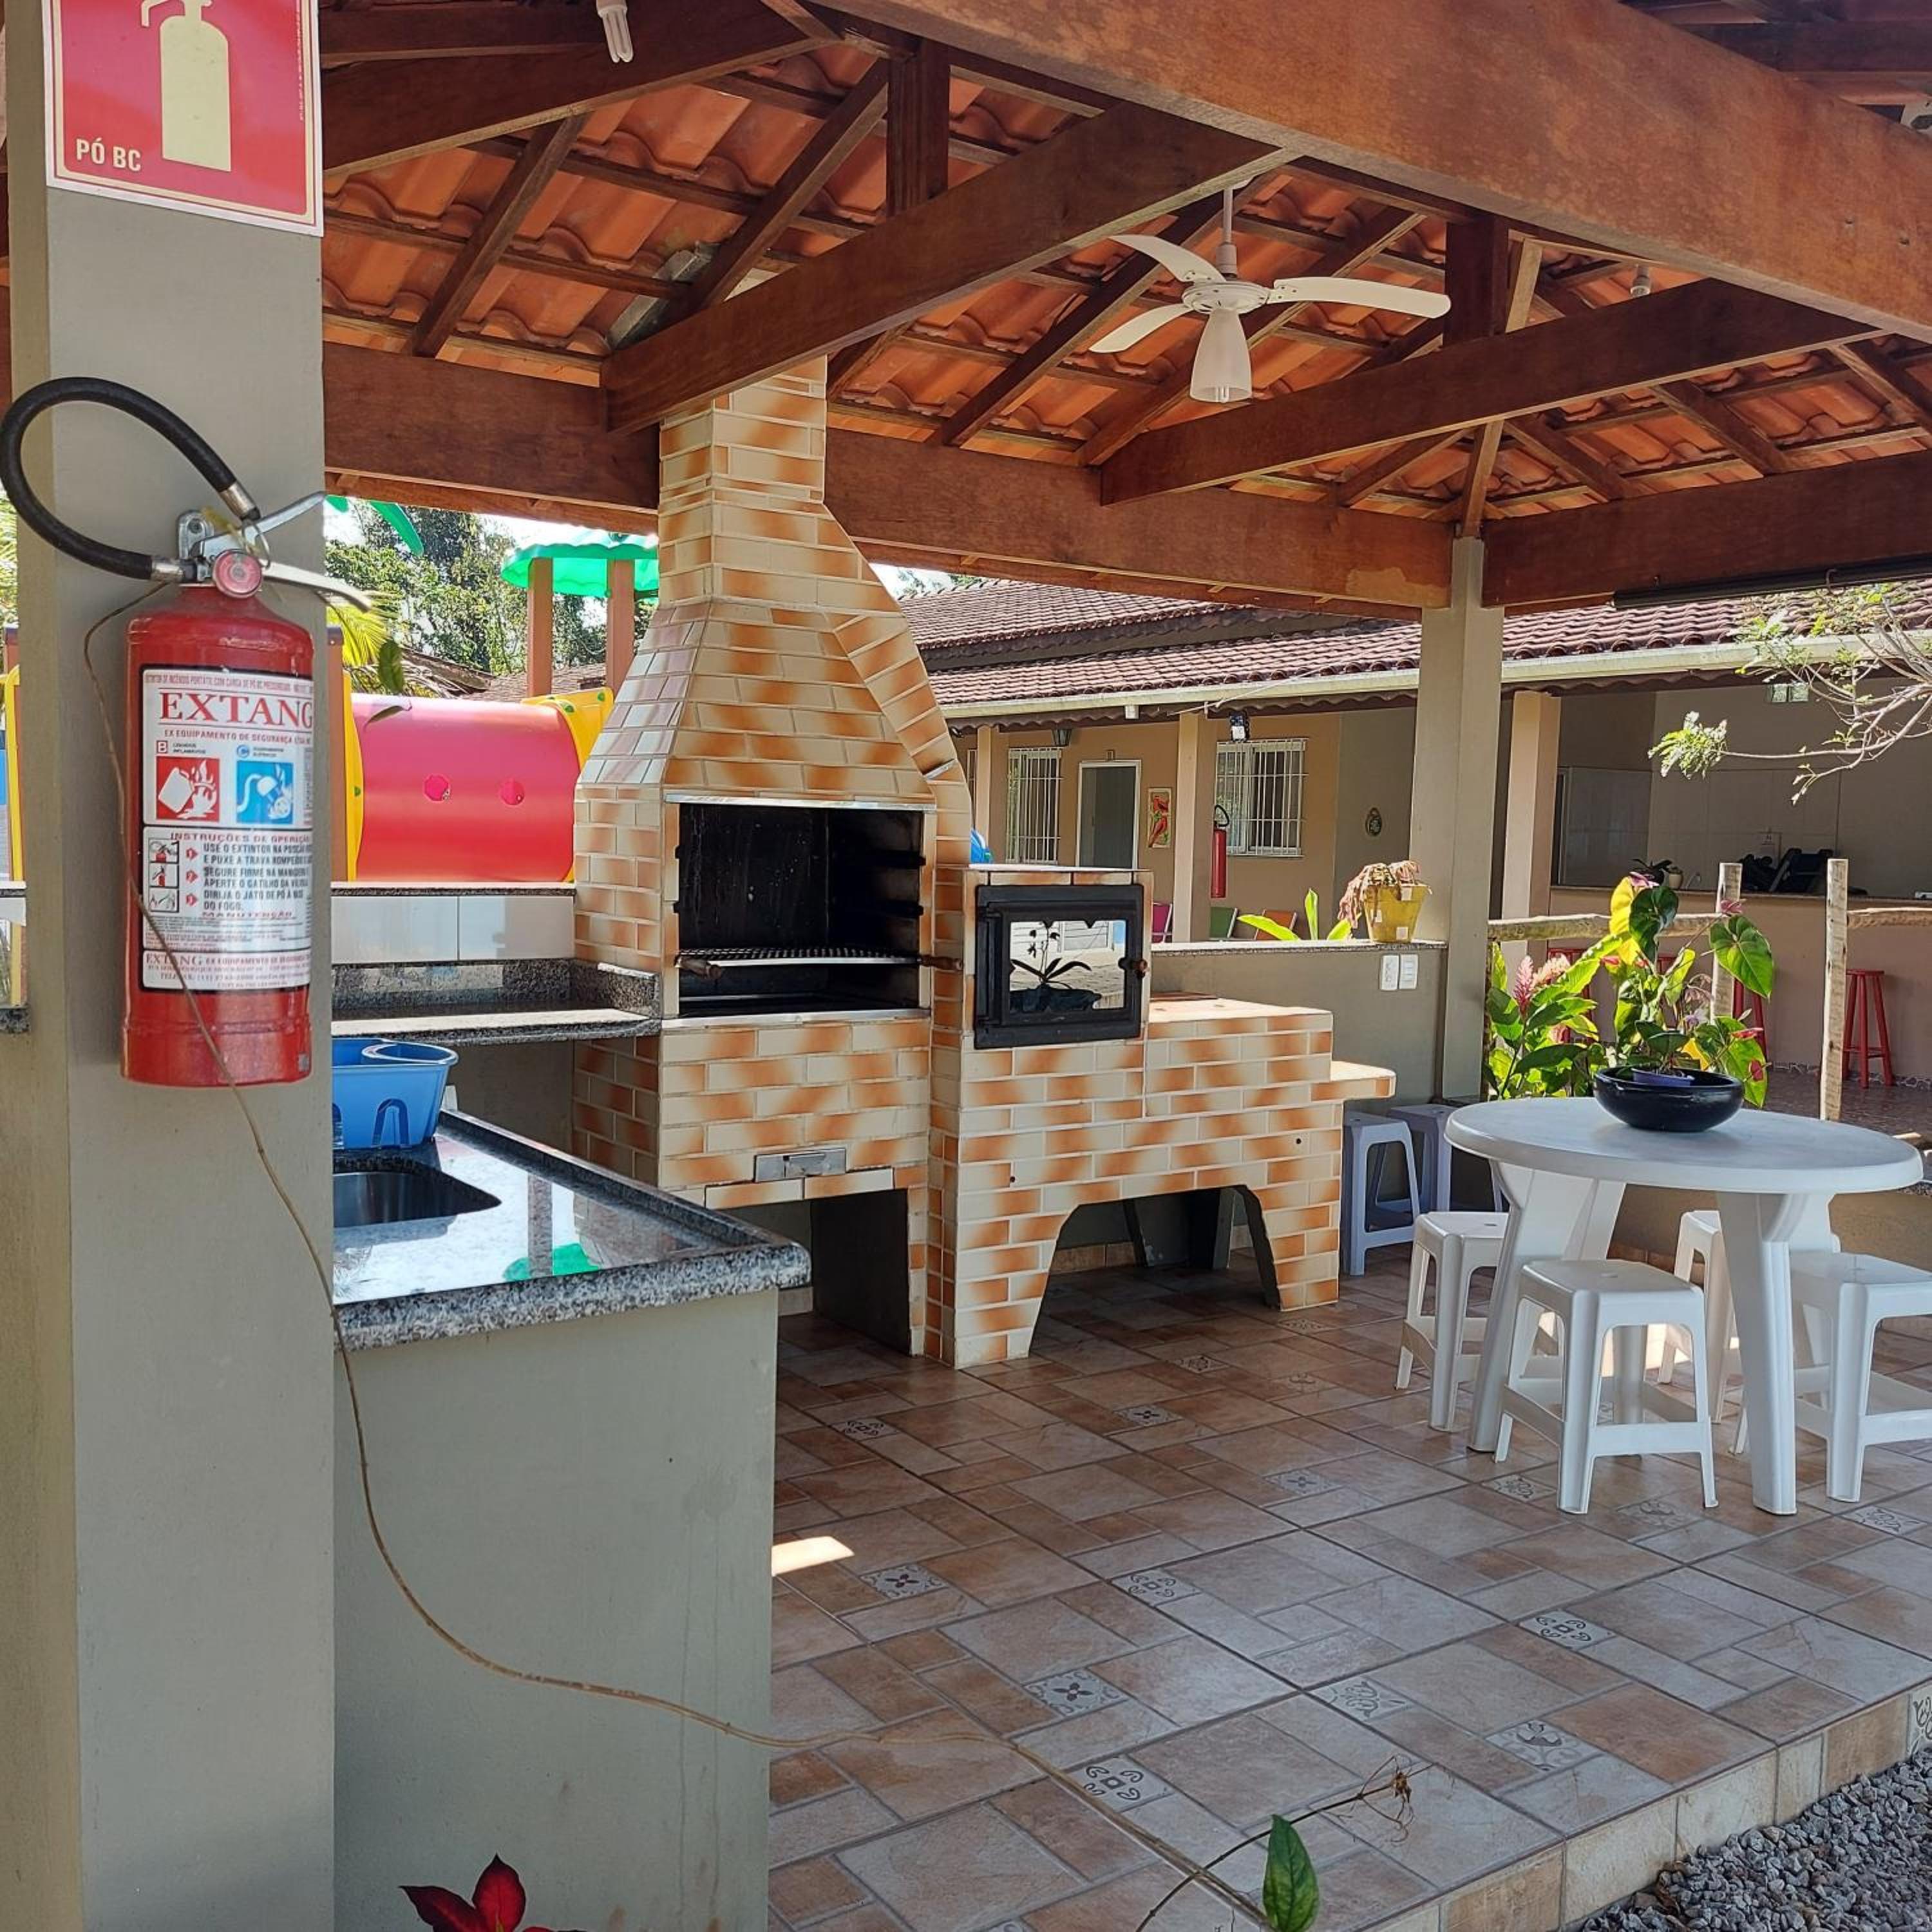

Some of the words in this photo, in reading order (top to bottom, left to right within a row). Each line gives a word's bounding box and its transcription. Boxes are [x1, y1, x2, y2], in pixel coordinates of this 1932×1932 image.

[75, 137, 105, 164] PÓ
[113, 146, 141, 171] BC
[160, 692, 312, 729] EXTANG
[176, 730, 236, 740] EQUIPAMENTO
[252, 734, 292, 744] SEGURANÇA
[158, 741, 167, 753] B
[237, 745, 249, 757] C
[171, 833, 249, 843] INSTRUÇÕES
[204, 843, 220, 852] USE
[223, 844, 229, 853] O
[232, 844, 270, 853] EXTINTOR
[204, 855, 208, 863] E
[211, 855, 232, 864] PUXE
[237, 855, 242, 864] A
[245, 855, 270, 865] TRAVA
[204, 866, 236, 876] SEGURE
[240, 868, 263, 876] FIRME
[204, 878, 234, 887] APERTE
[240, 879, 245, 887] O
[247, 878, 278, 887] GATILHO
[204, 890, 231, 899] DIRIJA
[236, 891, 240, 900] O
[243, 891, 263, 900] JATO
[266, 891, 274, 899] DE
[204, 901, 216, 910] DO
[146, 953, 202, 965] EXTNG
